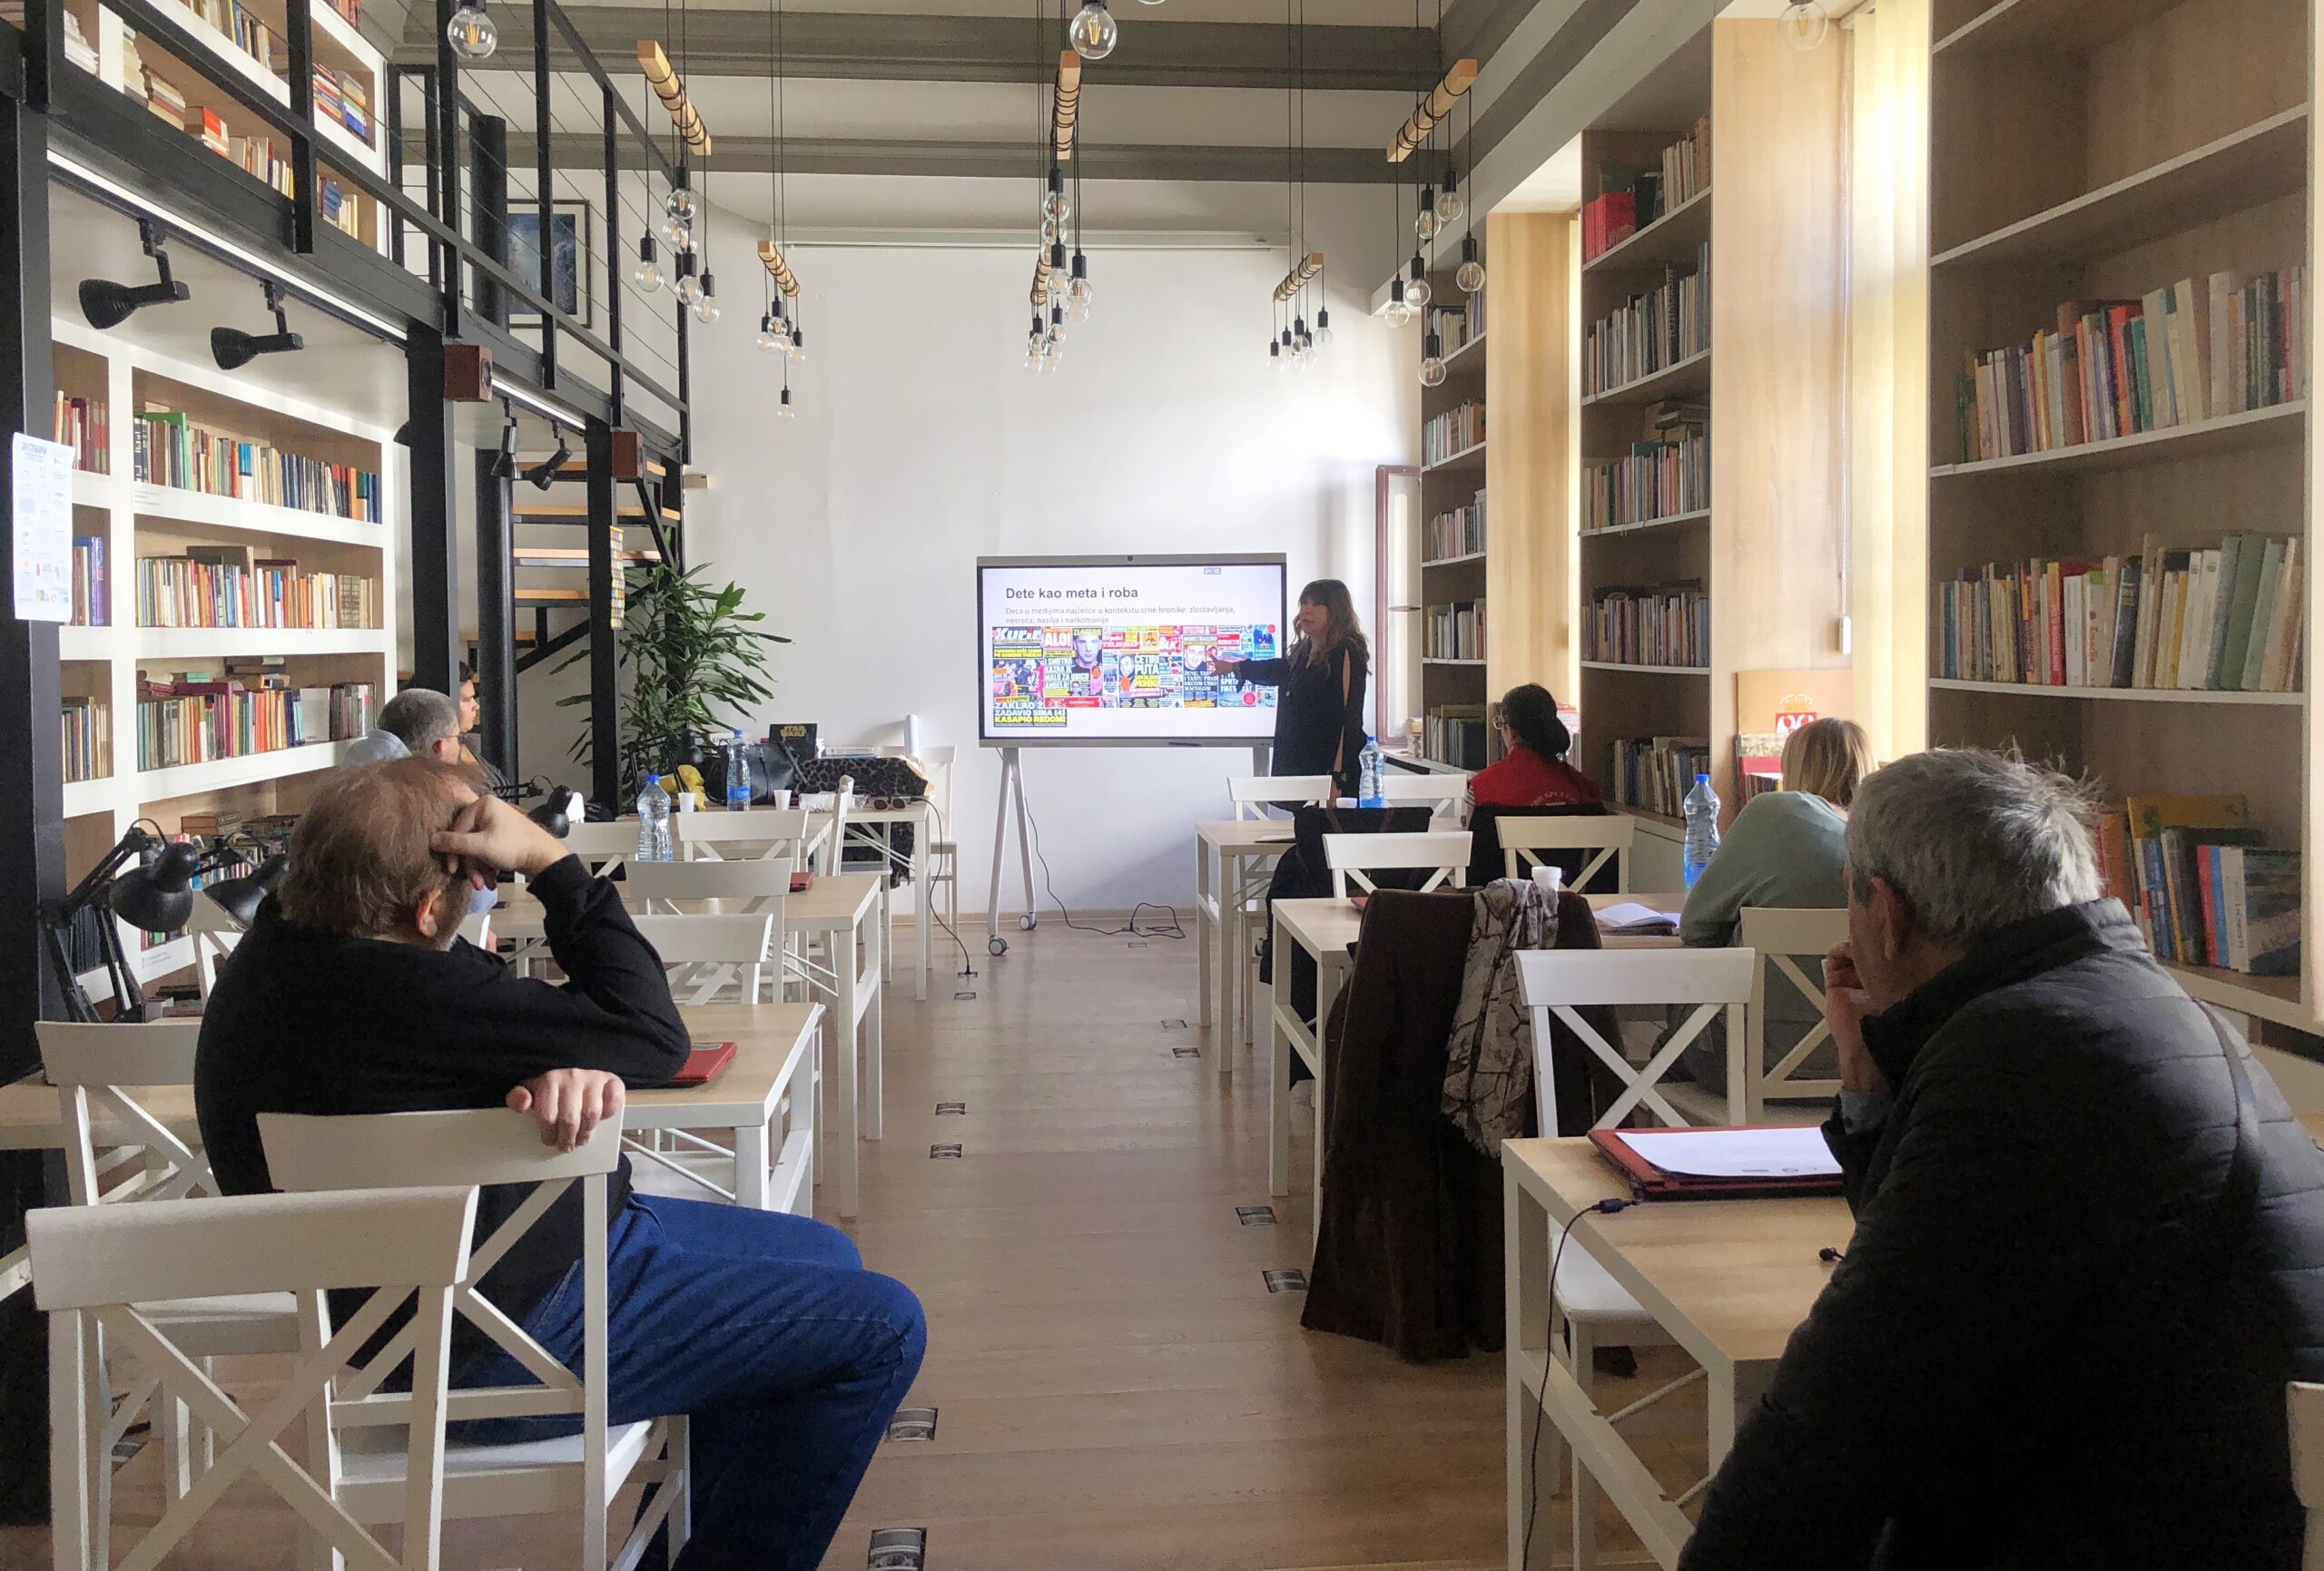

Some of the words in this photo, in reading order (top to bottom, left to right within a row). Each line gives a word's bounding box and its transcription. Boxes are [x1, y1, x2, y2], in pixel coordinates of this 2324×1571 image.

[1006, 588, 1035, 599] Dete
[1039, 588, 1062, 599] kao
[1066, 588, 1097, 598] meta
[1101, 587, 1105, 598] i
[1108, 587, 1138, 598] roba
[1006, 607, 1023, 615] Deca
[1031, 607, 1064, 616] medijima
[1066, 606, 1097, 616] najčešće
[1105, 606, 1139, 614] kontekstu
[1189, 605, 1236, 614] zlostavljanja,
[1006, 617, 1035, 625] nesreća,
[1037, 617, 1059, 625] nasilja
[1065, 617, 1109, 625] narkomanije
[1044, 633, 1071, 647] ALO!
[1135, 664, 1159, 675] PUTA
[781, 730, 806, 738] WARS
